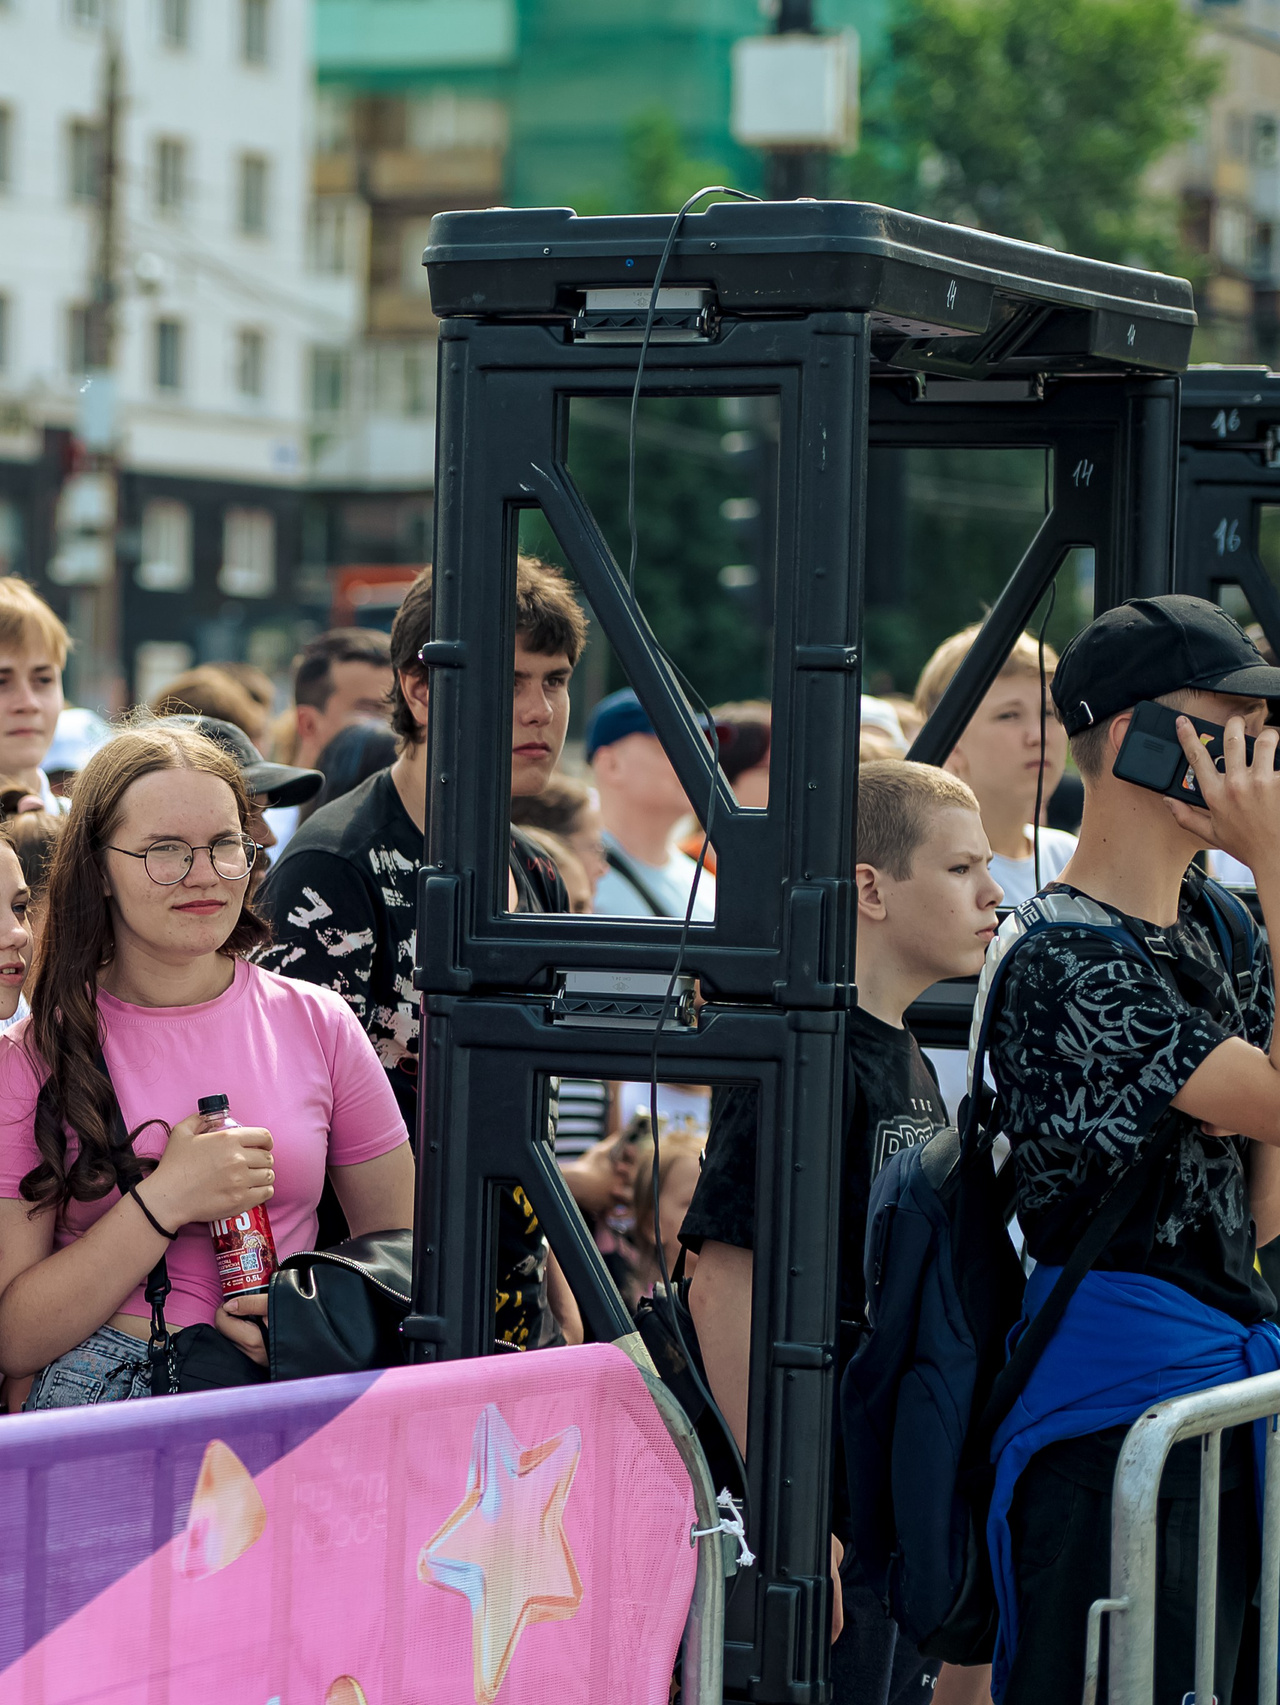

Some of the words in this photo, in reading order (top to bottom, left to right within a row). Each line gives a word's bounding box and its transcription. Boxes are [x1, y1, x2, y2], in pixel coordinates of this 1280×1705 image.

[946, 279, 957, 310] 14
[1211, 408, 1241, 438] 16
[1072, 459, 1094, 487] 14
[1213, 517, 1241, 556] 16
